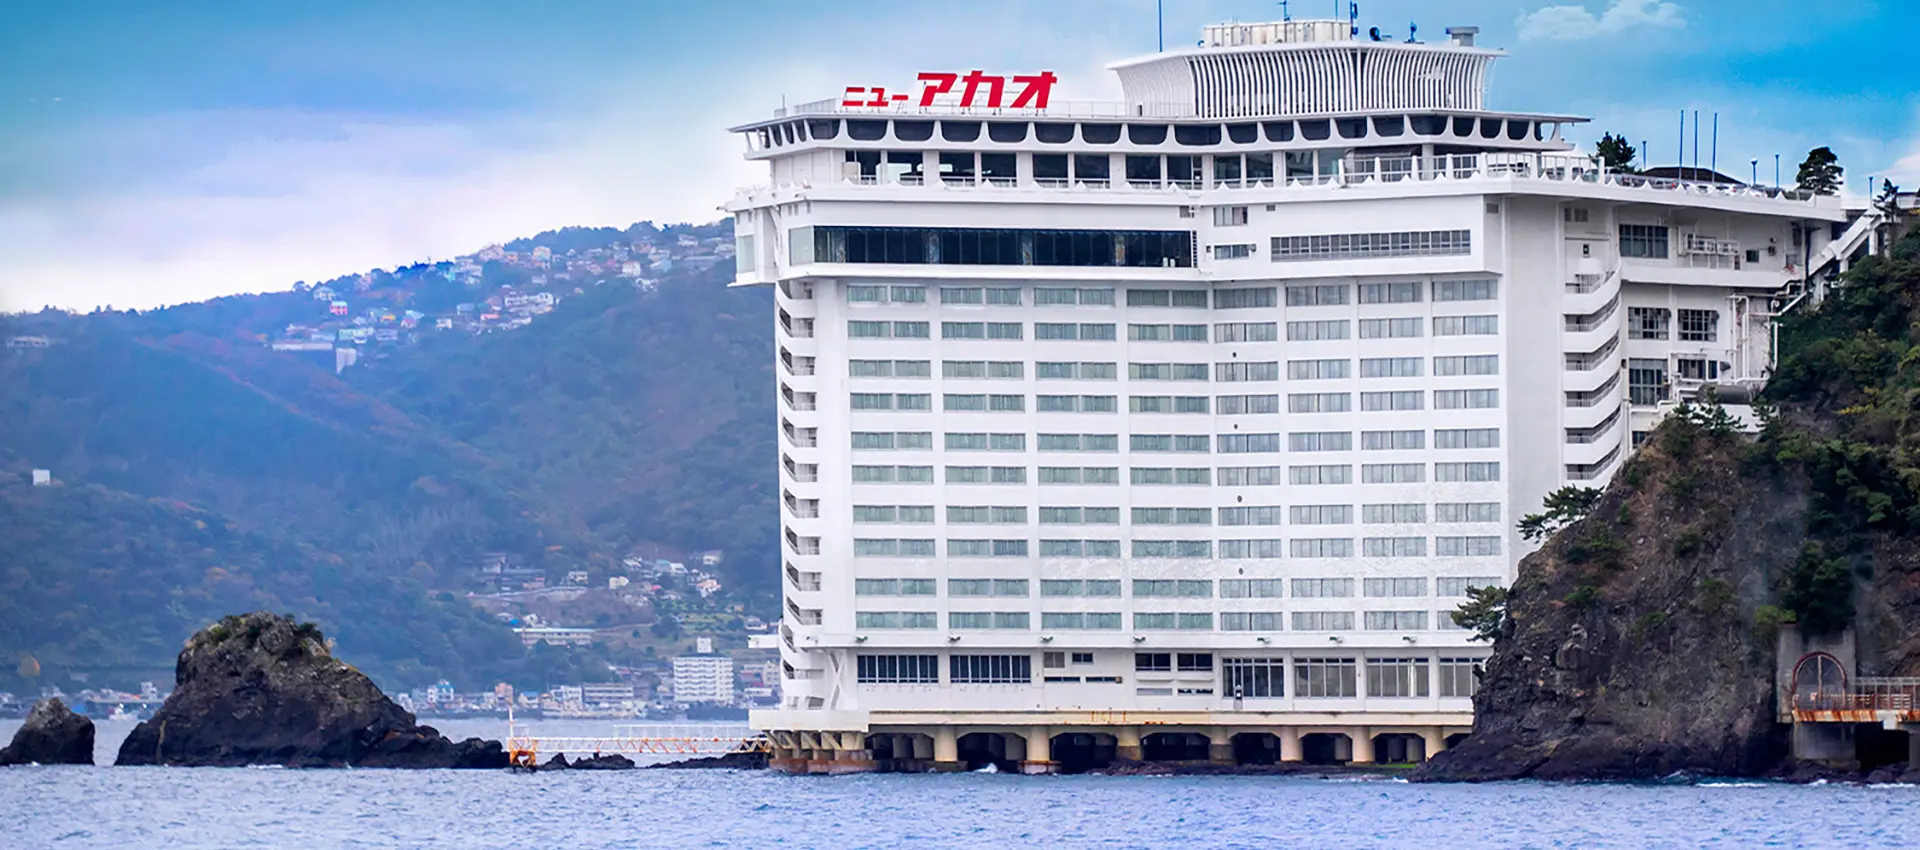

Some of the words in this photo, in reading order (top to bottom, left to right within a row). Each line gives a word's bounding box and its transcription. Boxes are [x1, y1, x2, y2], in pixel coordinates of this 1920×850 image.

[842, 70, 1057, 108] ニューアカオ
